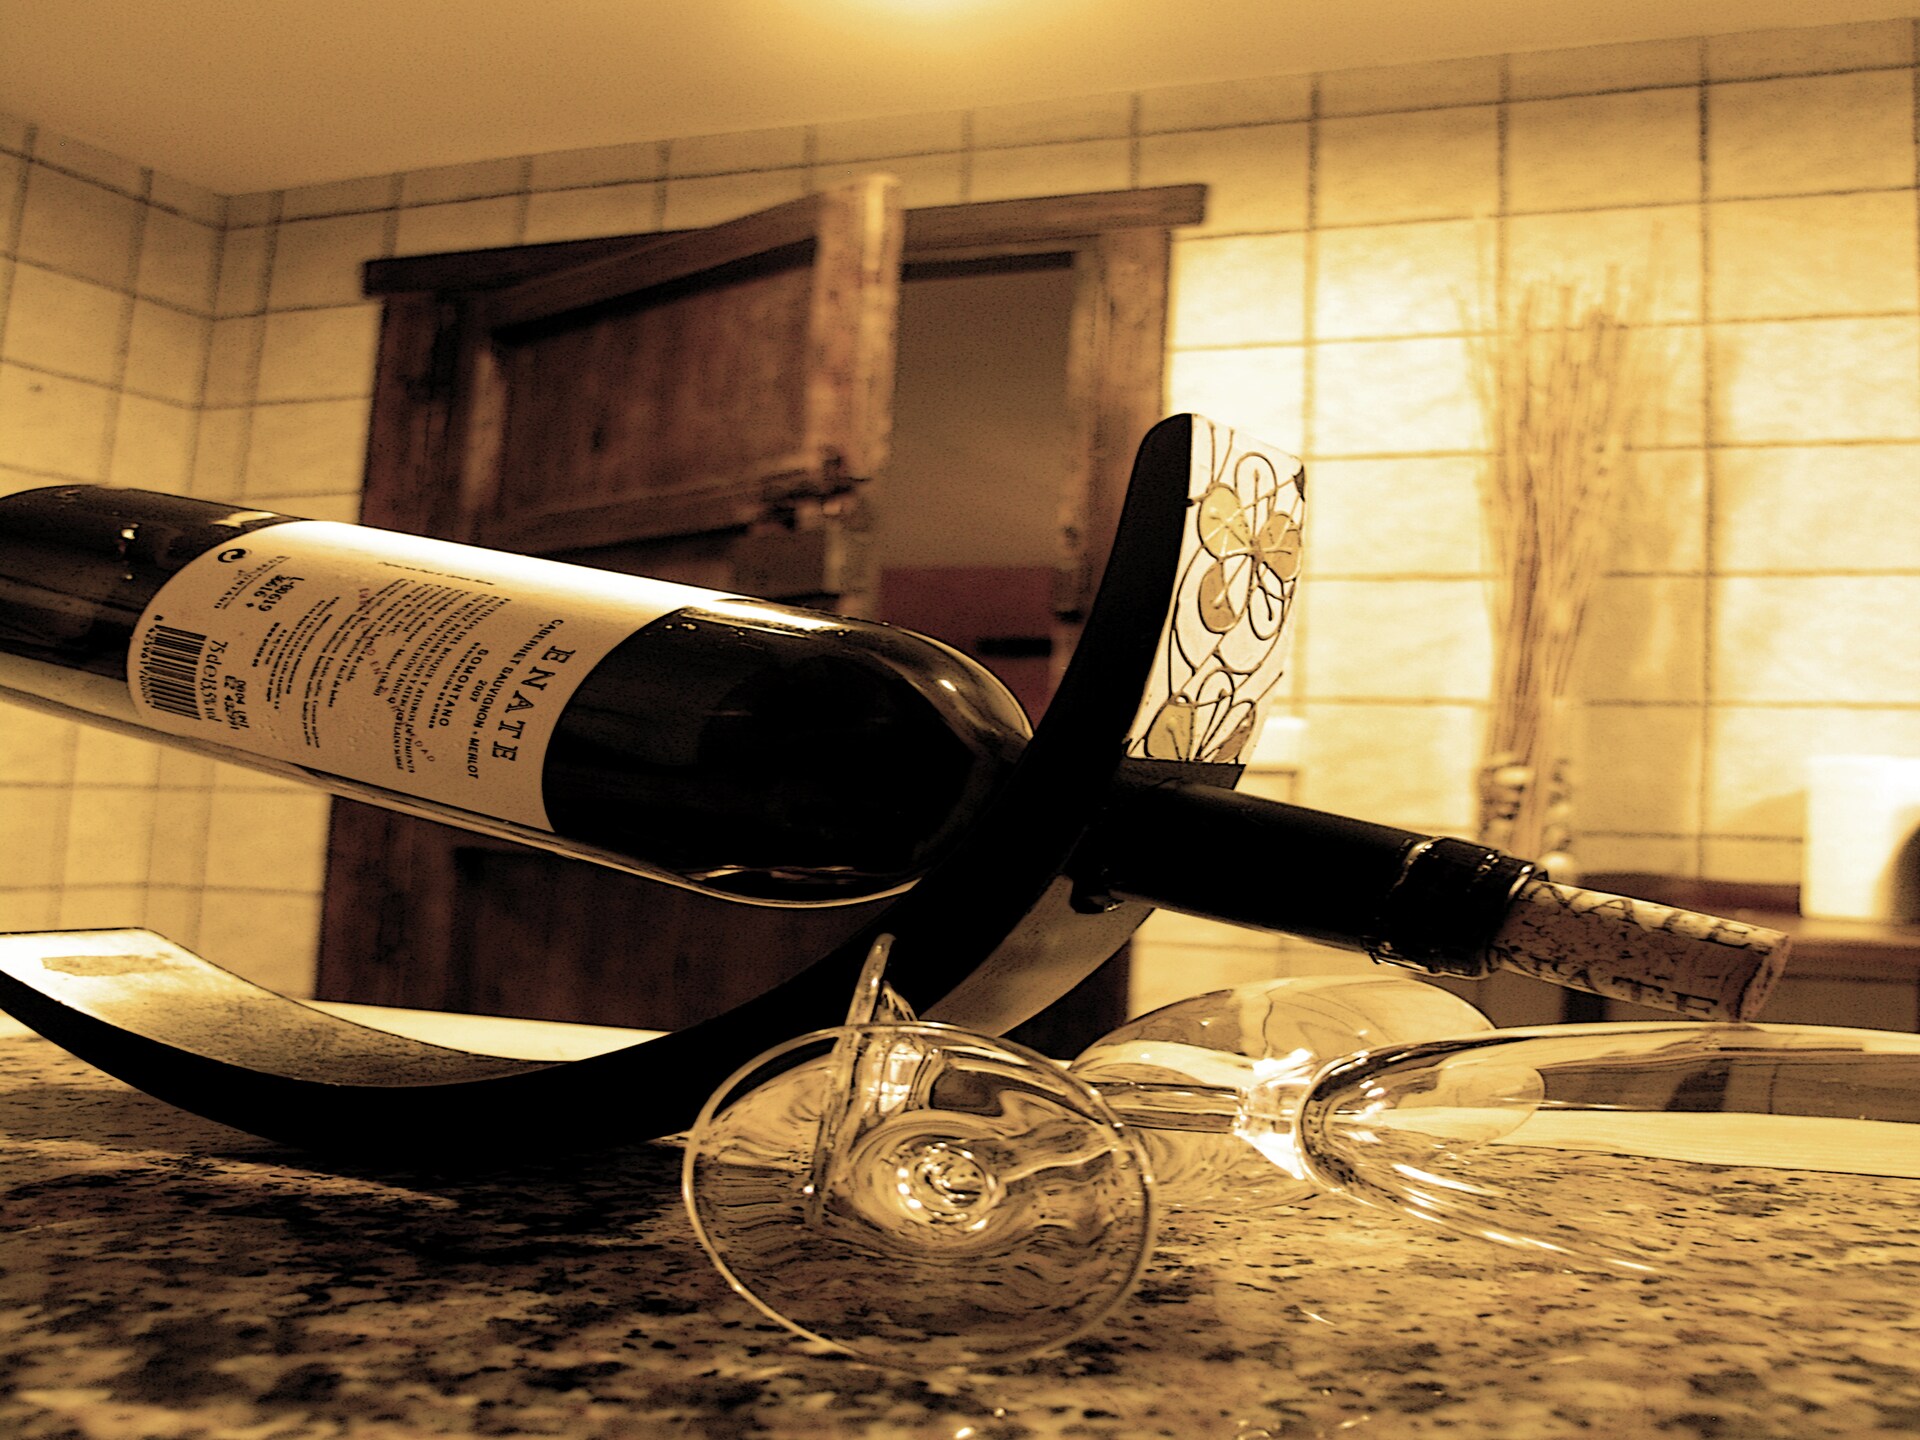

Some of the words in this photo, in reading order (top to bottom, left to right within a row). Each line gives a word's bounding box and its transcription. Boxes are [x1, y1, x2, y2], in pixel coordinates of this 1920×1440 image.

[509, 618, 564, 665] CABERNET
[438, 648, 489, 727] SOMONTANO
[468, 679, 488, 703] 2007
[472, 666, 514, 729] SAUVIGNON
[491, 644, 577, 762] ENATE
[466, 736, 480, 779] MERLOT
